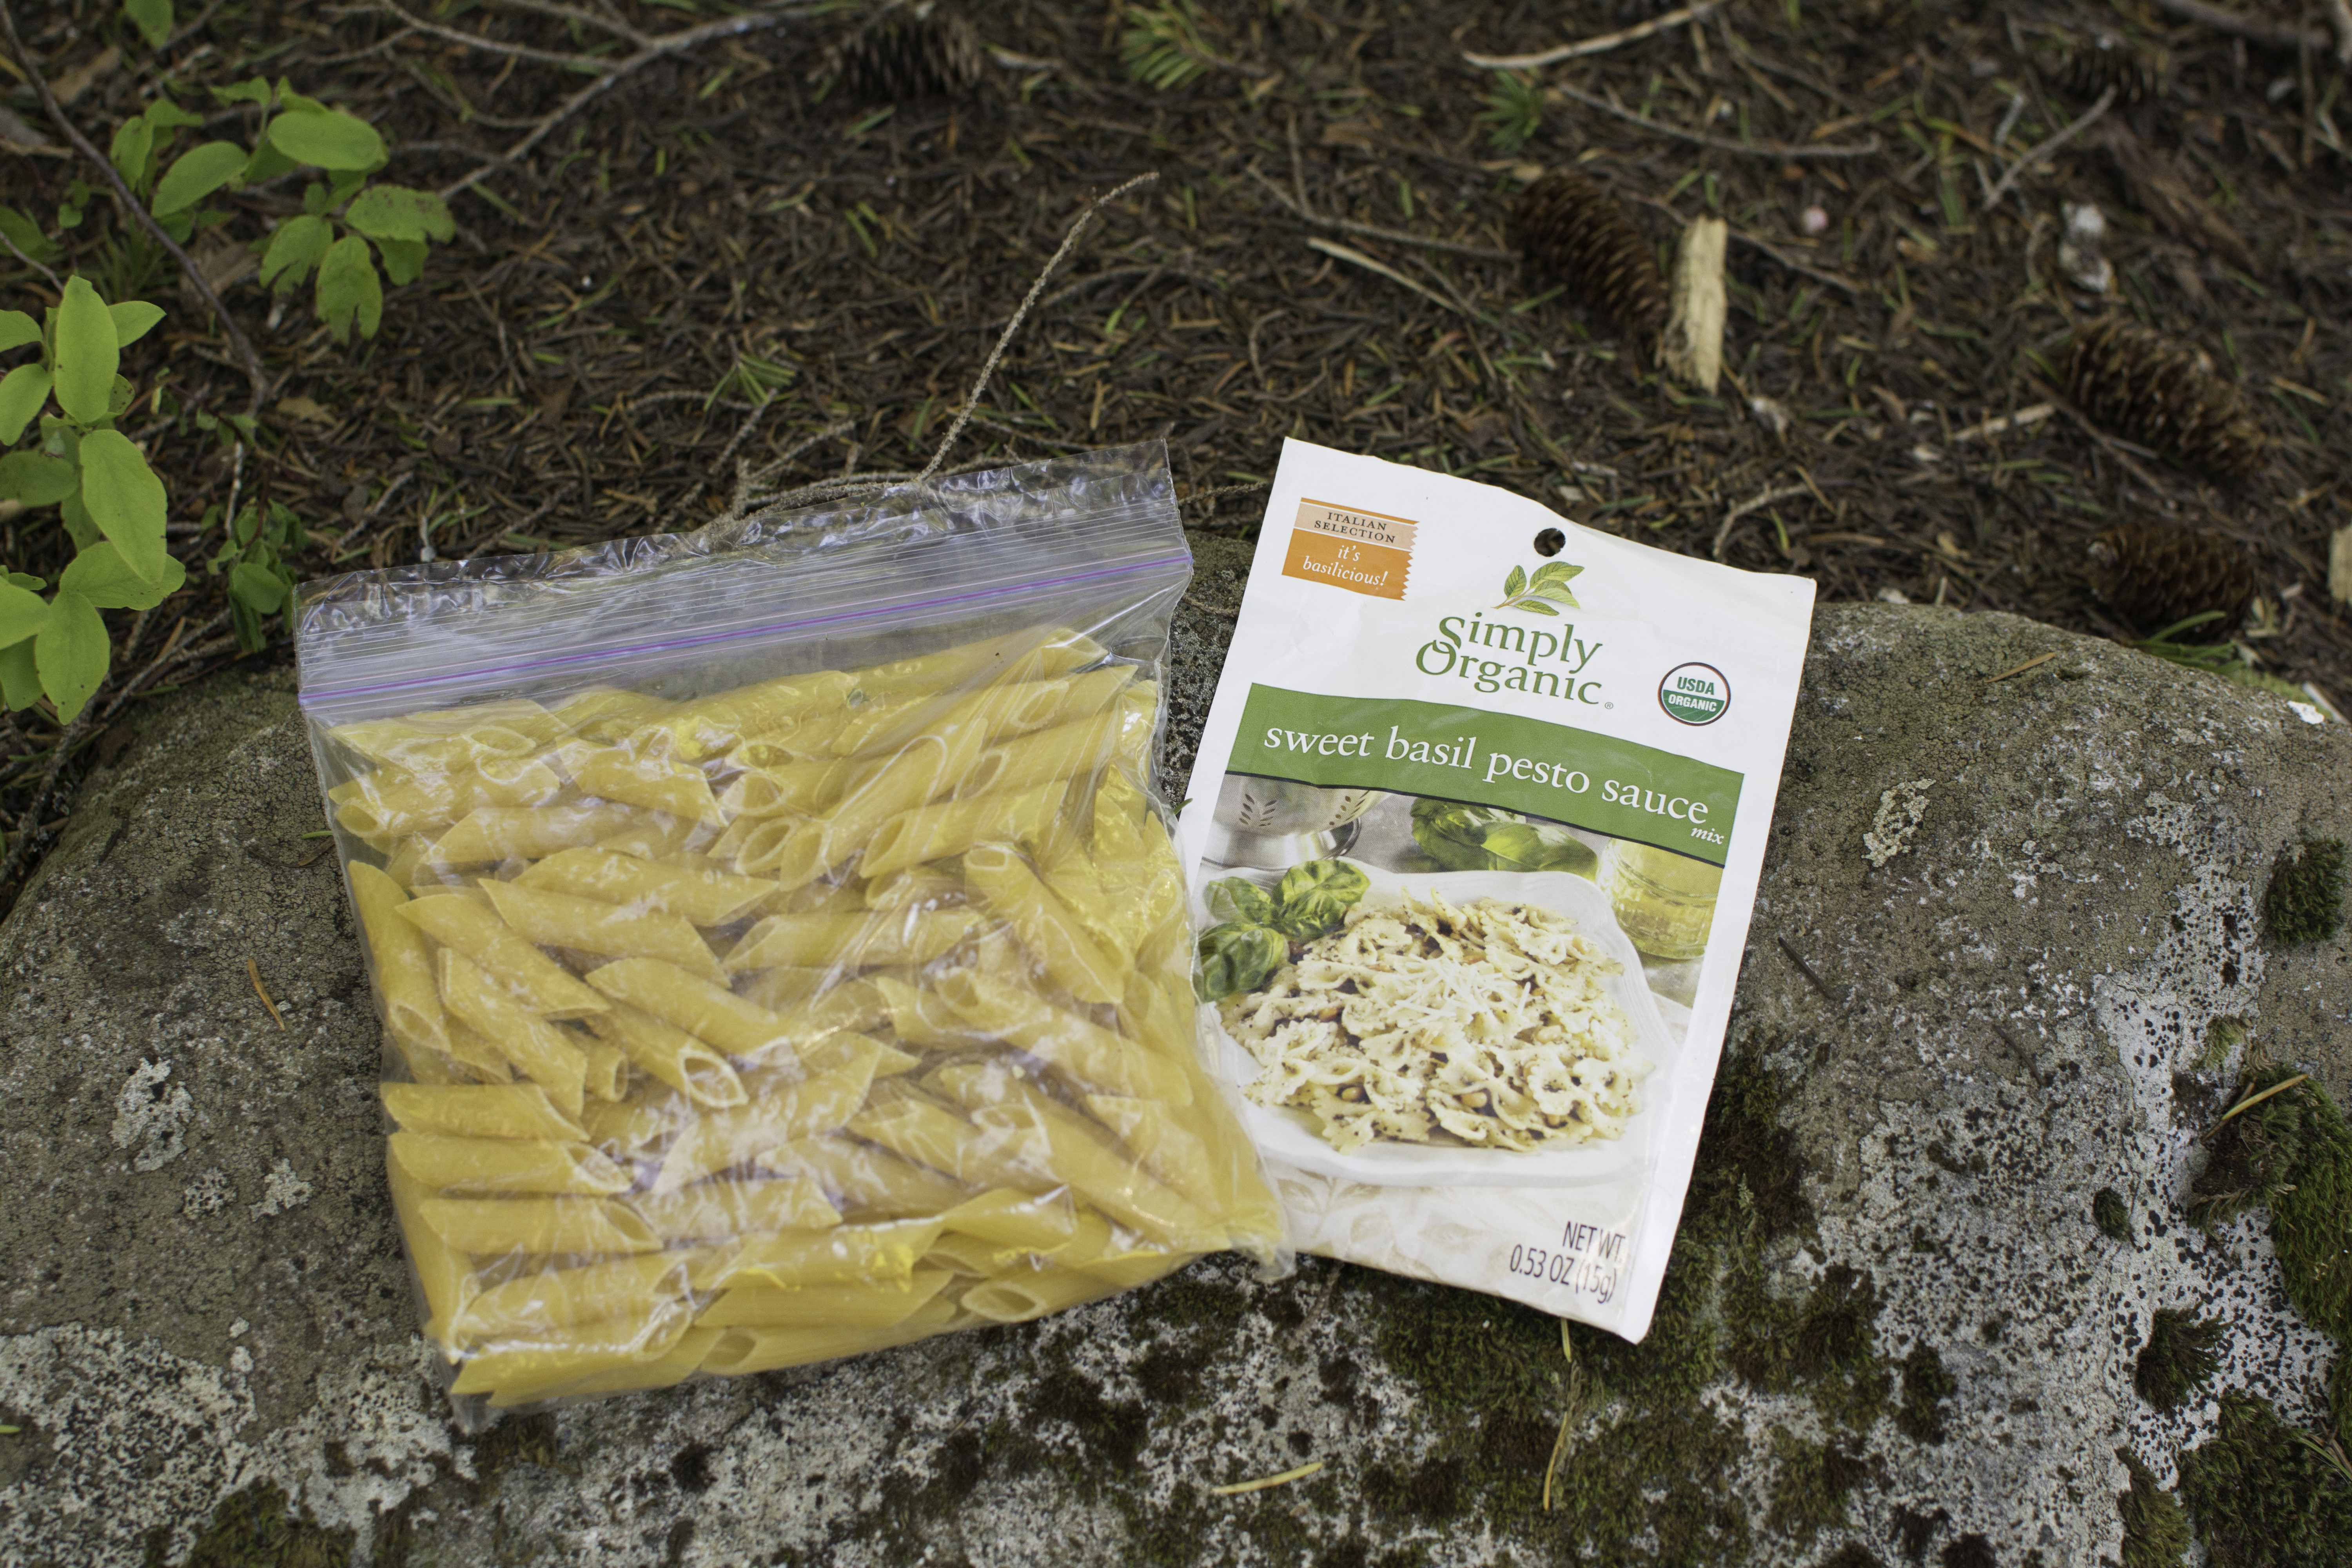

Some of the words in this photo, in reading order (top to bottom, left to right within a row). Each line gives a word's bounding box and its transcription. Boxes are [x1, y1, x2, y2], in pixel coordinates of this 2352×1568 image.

[1314, 520, 1396, 543] SELECTION
[1327, 512, 1387, 530] ITALIAN
[1338, 545, 1360, 561] it's
[1303, 556, 1388, 586] basilicious!
[1439, 612, 1602, 674] Simply
[1416, 640, 1602, 704] Organic
[1677, 677, 1714, 695] USDA
[1668, 694, 1717, 712] ORGANIC
[1264, 727, 1374, 756] sweet
[1385, 726, 1476, 769] basil
[1482, 752, 1590, 793] pesto
[1601, 780, 1708, 824] sauce
[1691, 826, 1724, 845] mix
[1563, 1221, 1597, 1253] NET
[1510, 1244, 1546, 1278] 0.53
[1550, 1255, 1574, 1285] OZ
[1575, 1259, 1617, 1304] (15g)
